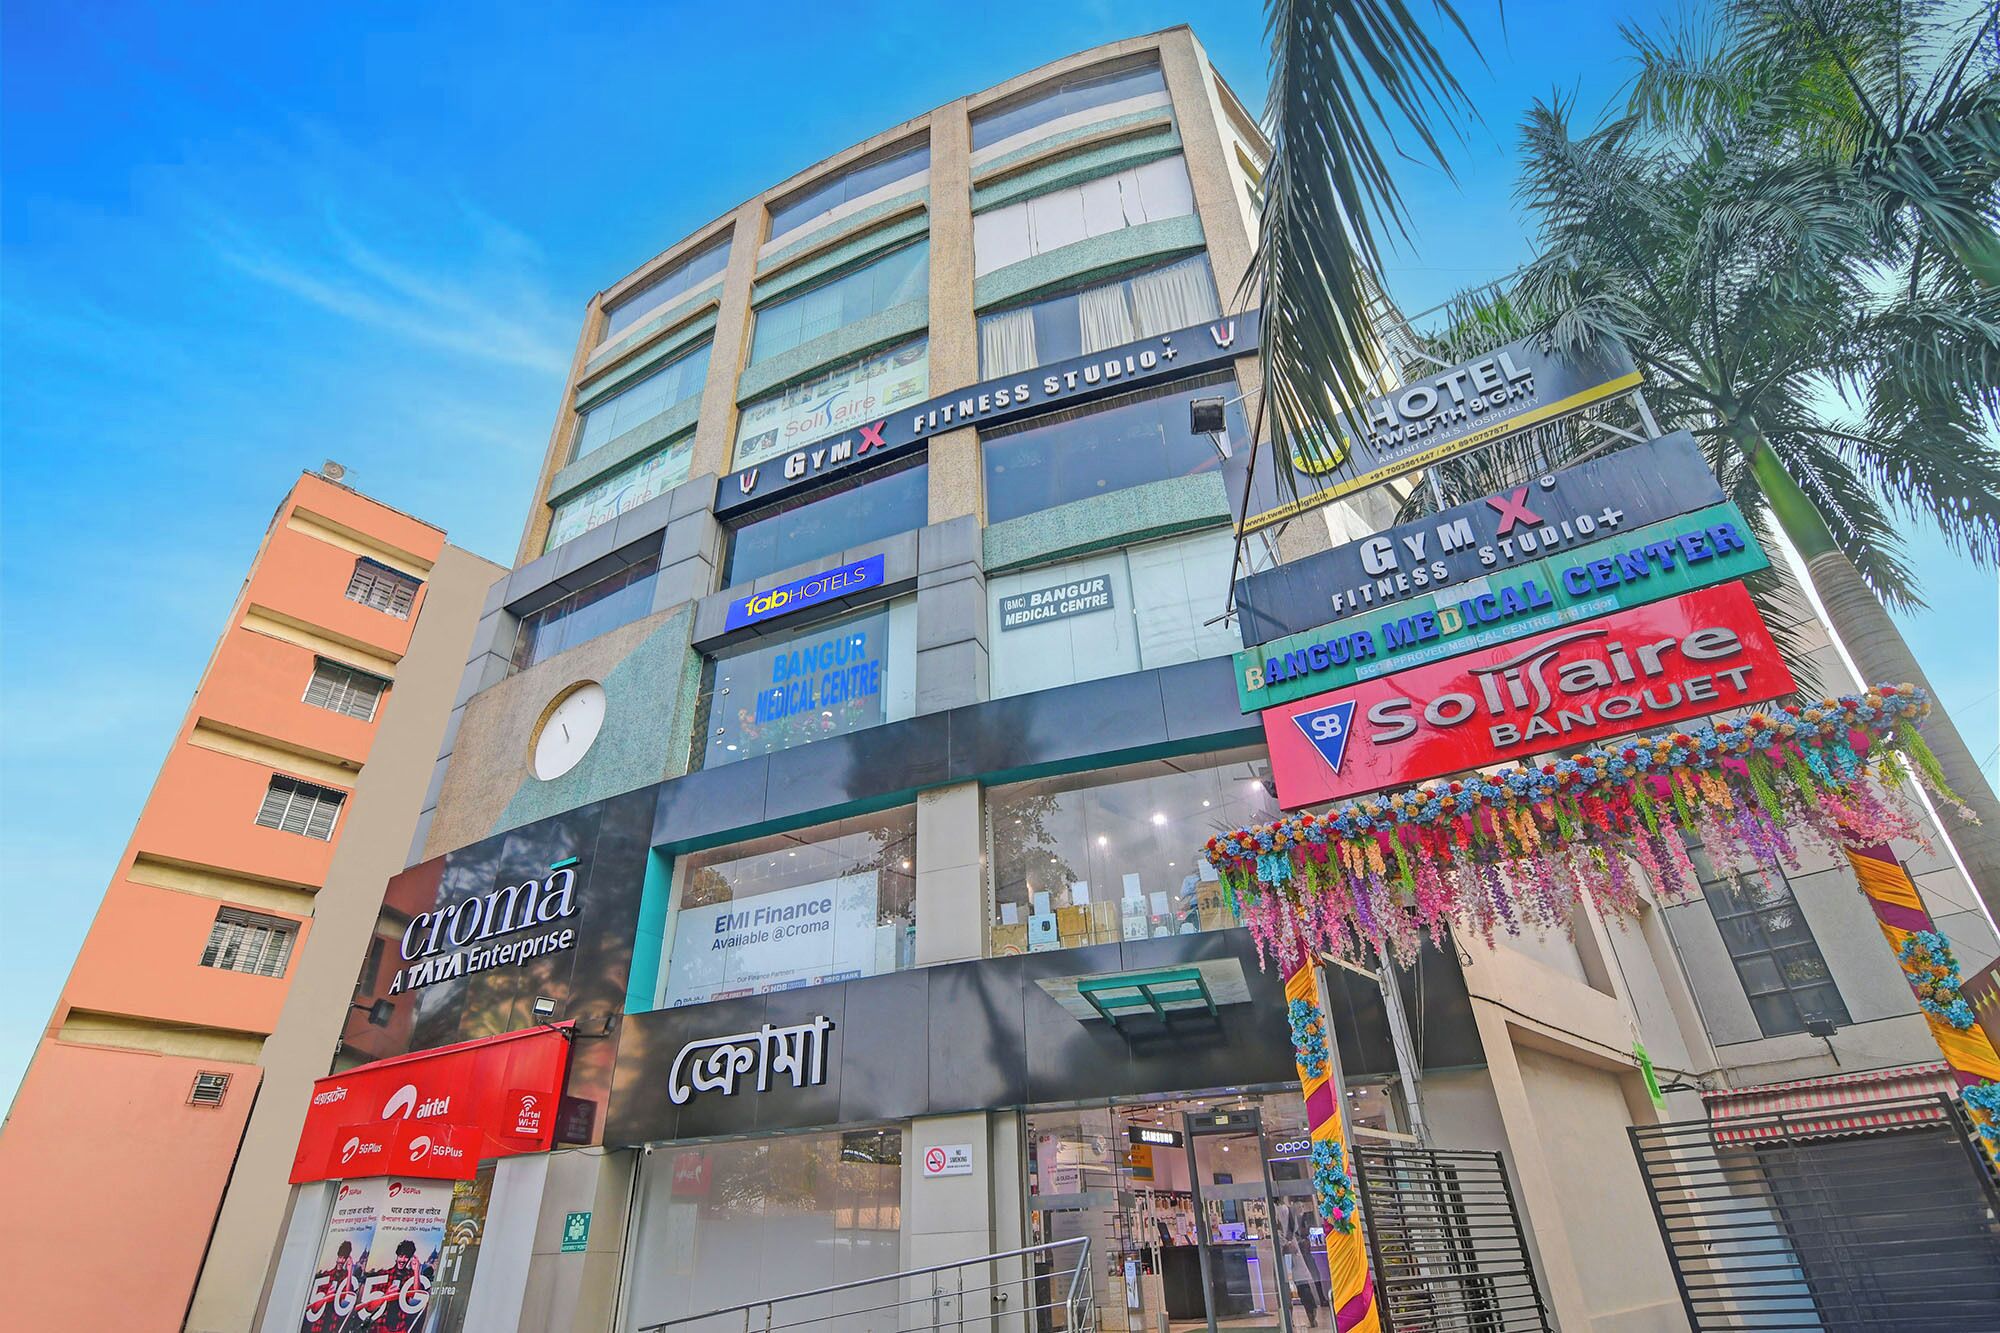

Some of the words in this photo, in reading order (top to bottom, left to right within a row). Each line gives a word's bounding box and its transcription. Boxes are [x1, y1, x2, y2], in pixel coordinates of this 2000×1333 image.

[913, 383, 1030, 434] FITNESS
[1366, 351, 1533, 435] HOTEL
[1370, 404, 1467, 452] TWELFTH
[1378, 453, 1397, 464] AN
[1397, 445, 1420, 458] UNIT
[1422, 437, 1440, 448] OF
[1441, 426, 1465, 441] M.S.
[1466, 395, 1541, 431] HOSPITALITY
[1245, 493, 1329, 528] www.twelfthight.in
[1004, 596, 1026, 612] (BMC)
[1030, 579, 1104, 607] BANGUR
[1245, 630, 1377, 692] BANGUR
[1381, 580, 1553, 652] MEDICAL
[1562, 523, 1746, 596] CENTER
[1332, 561, 1449, 612] FITNESS
[1005, 604, 1057, 626] MEDICAL
[1060, 592, 1108, 613] CENTRE
[1383, 646, 1446, 670] APPROVED
[1449, 629, 1500, 650] MEDICAL
[1581, 598, 1614, 616] Floor
[772, 632, 867, 684] BANGUR
[755, 677, 816, 726] MEDICAL
[821, 659, 880, 708] CENTRE
[1489, 665, 1754, 749] BANQUET
[1313, 713, 1343, 741] SB
[711, 929, 769, 952] Available
[772, 918, 831, 943] @Croma
[714, 914, 749, 934] EMI
[754, 898, 832, 927] Finance
[388, 969, 403, 995] A
[408, 952, 463, 989] TATA
[467, 928, 573, 974] Enterprise
[737, 976, 747, 984] Our
[748, 973, 770, 983] Finance
[770, 968, 795, 979] Partners
[668, 1015, 829, 1105] ক্রোমা
[416, 1095, 449, 1119] airtel
[518, 1109, 541, 1119] Airtel
[518, 1118, 539, 1127] Wi-Fi
[1141, 1130, 1174, 1144] SAMSUNG
[1275, 1140, 1310, 1153] oppo
